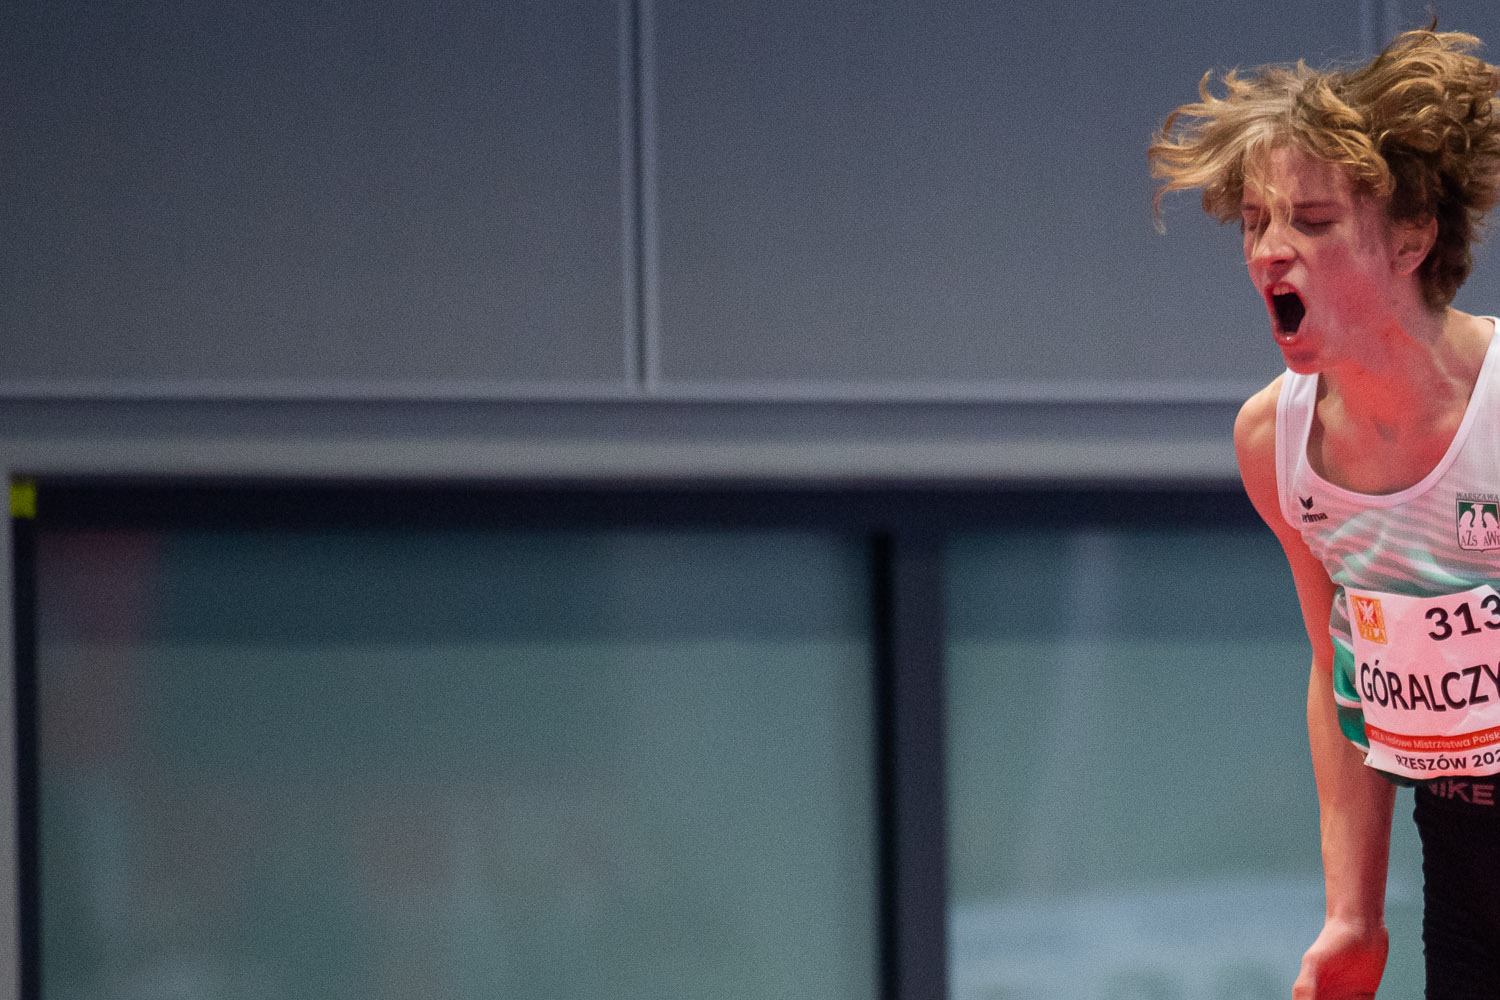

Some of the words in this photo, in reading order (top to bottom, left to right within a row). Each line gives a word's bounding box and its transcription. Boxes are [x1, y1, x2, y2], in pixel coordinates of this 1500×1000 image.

[1456, 492, 1499, 501] WARSZAWA
[1461, 530, 1478, 546] AZS
[1395, 753, 1467, 771] RZESZÓW
